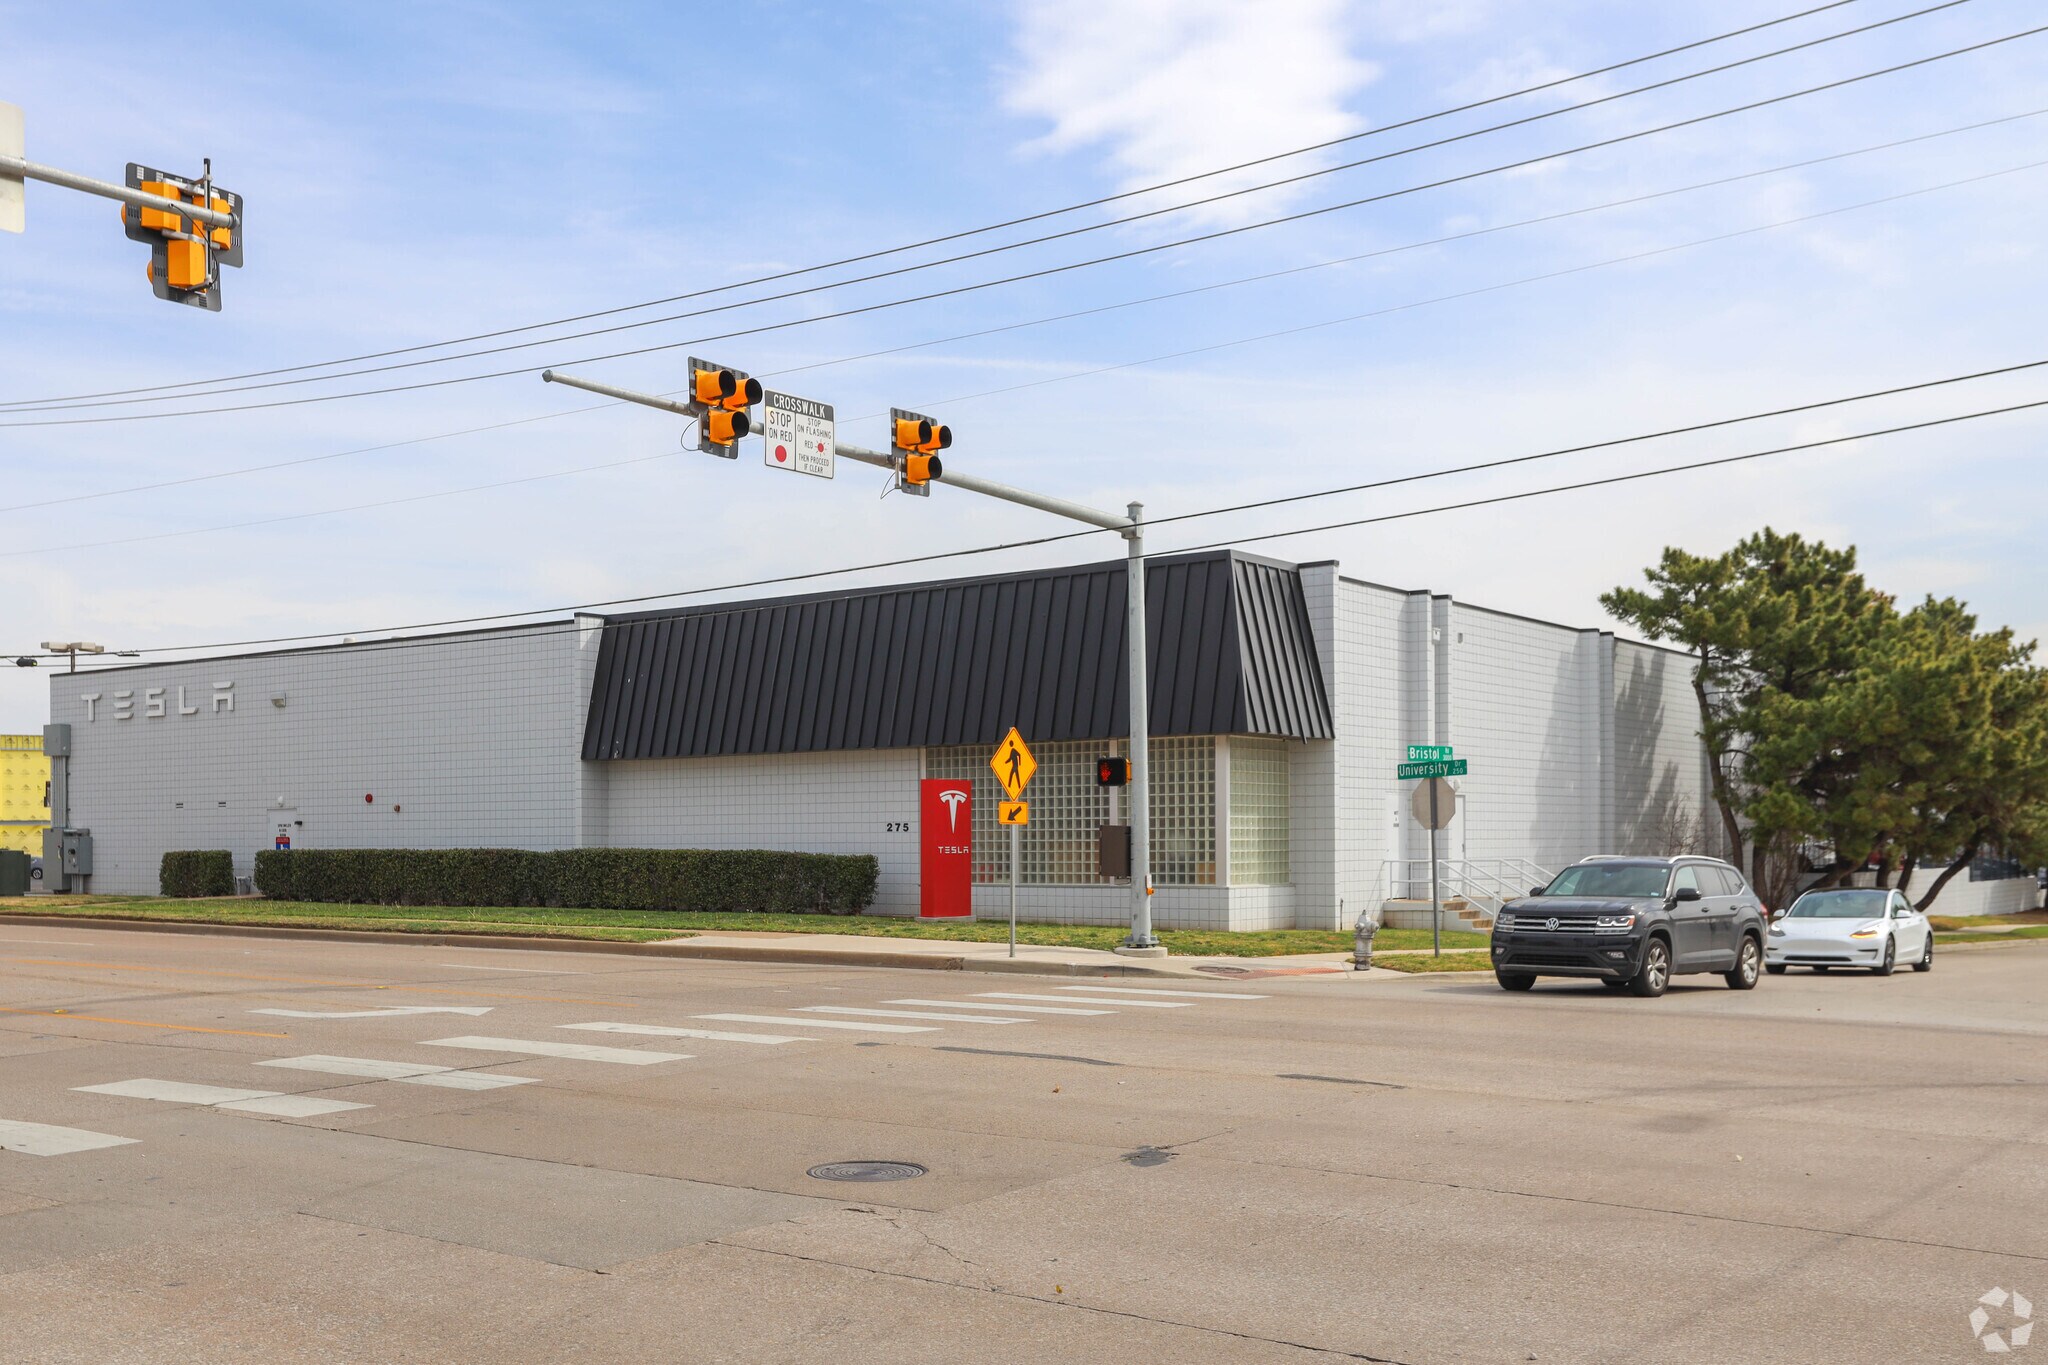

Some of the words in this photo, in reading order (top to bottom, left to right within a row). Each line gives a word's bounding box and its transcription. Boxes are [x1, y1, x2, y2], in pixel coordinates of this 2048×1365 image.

[773, 394, 826, 419] CROSSWALK
[769, 410, 791, 427] STOP
[808, 417, 821, 427] STOP
[768, 428, 777, 440] ON
[780, 430, 793, 442] RED
[797, 424, 805, 433] ON
[806, 426, 831, 440] FLASHING
[804, 440, 813, 449] RED
[798, 453, 809, 462] THEN
[810, 456, 829, 467] PROCEED
[809, 465, 824, 473] CLEAR
[80, 680, 235, 723] TESLA
[1409, 747, 1440, 759] Bristol
[1399, 763, 1448, 776] University
[1452, 767, 1464, 775] 250
[887, 822, 909, 832] 275
[938, 846, 969, 854] TESLA
